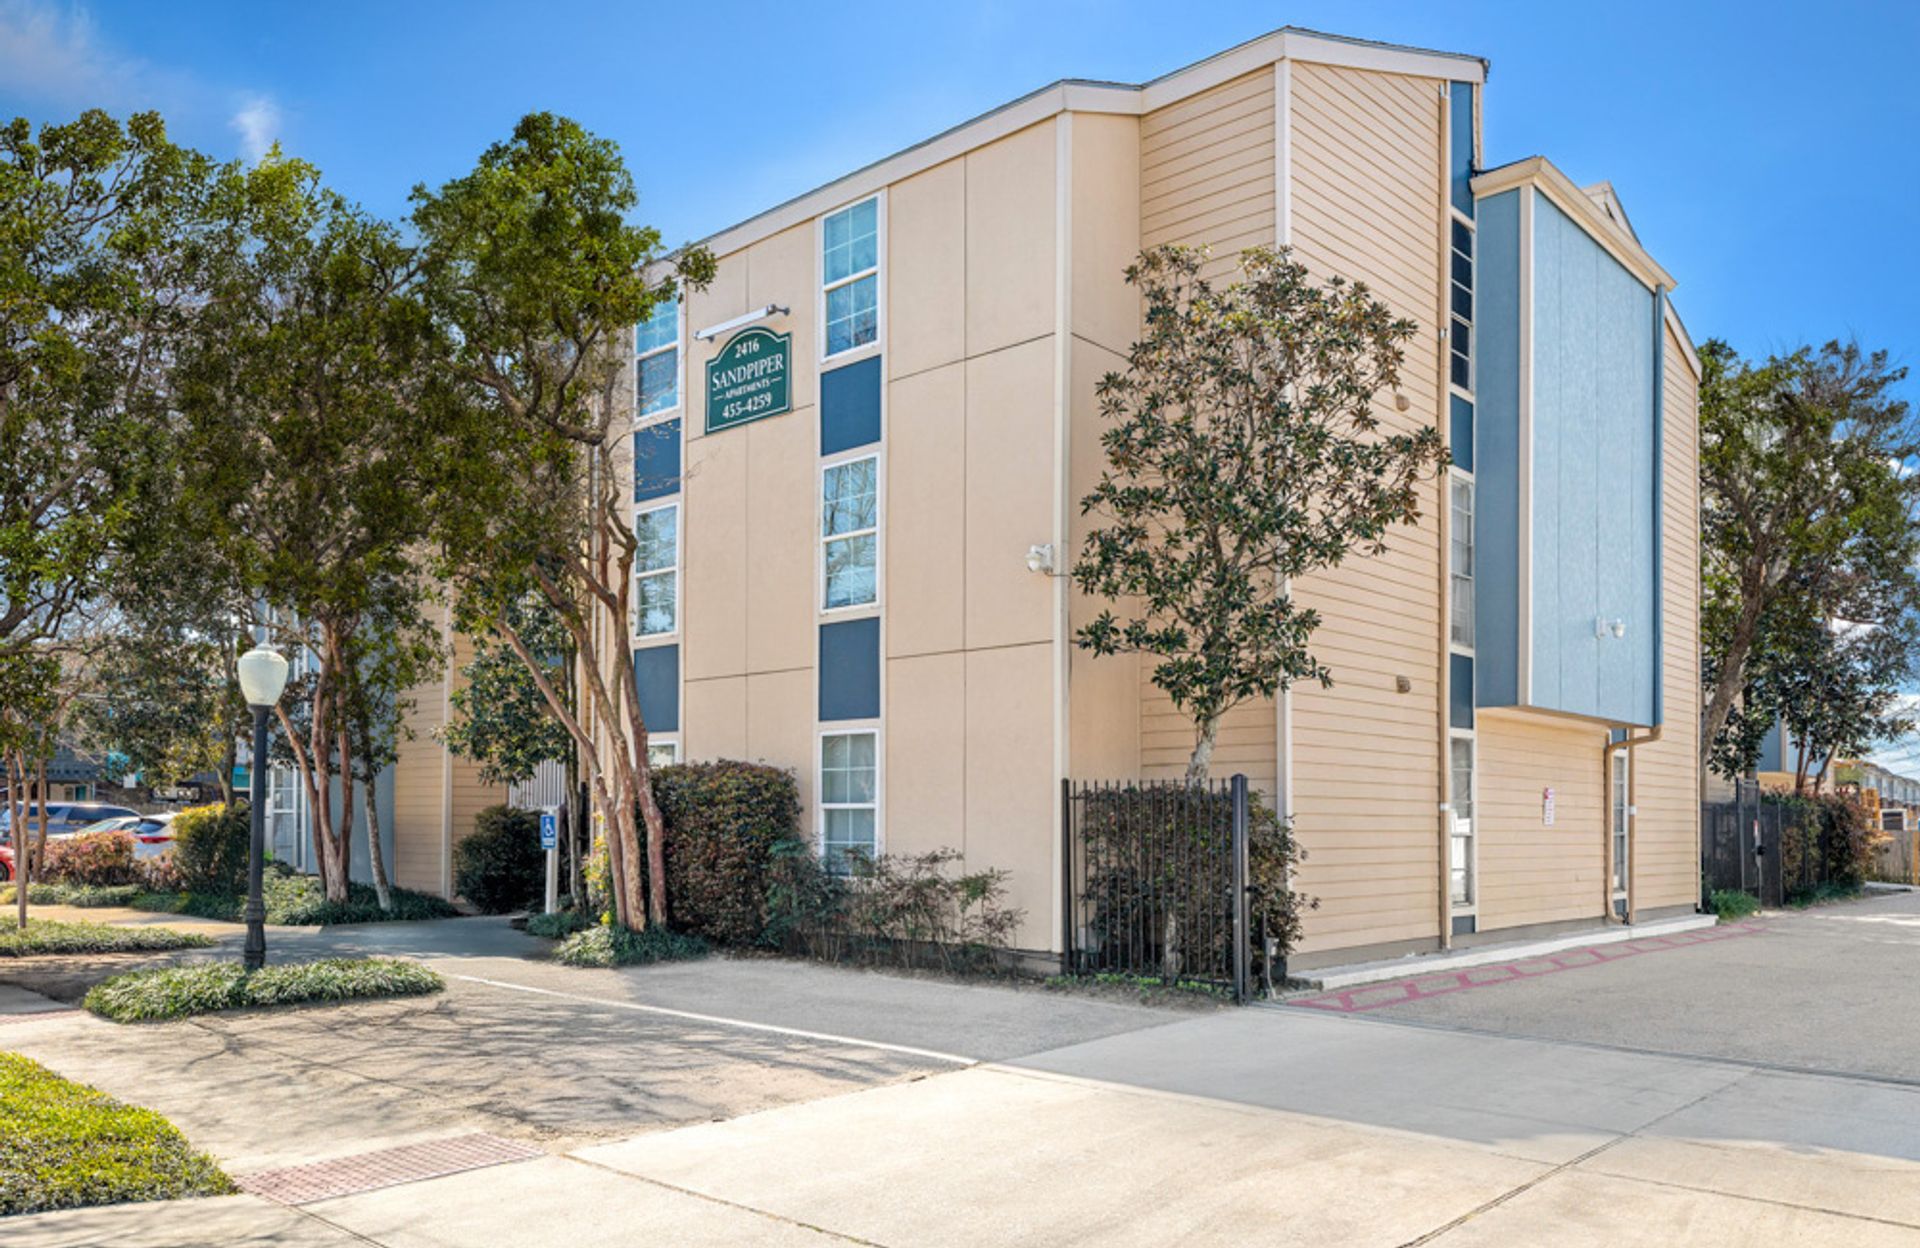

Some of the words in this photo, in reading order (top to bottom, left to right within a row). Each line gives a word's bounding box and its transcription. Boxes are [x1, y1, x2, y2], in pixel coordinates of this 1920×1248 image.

[735, 338, 760, 358] 2416
[712, 353, 784, 391] SANDPIPER
[725, 378, 771, 399] APARTMENTS
[722, 392, 772, 418] 455-4259
